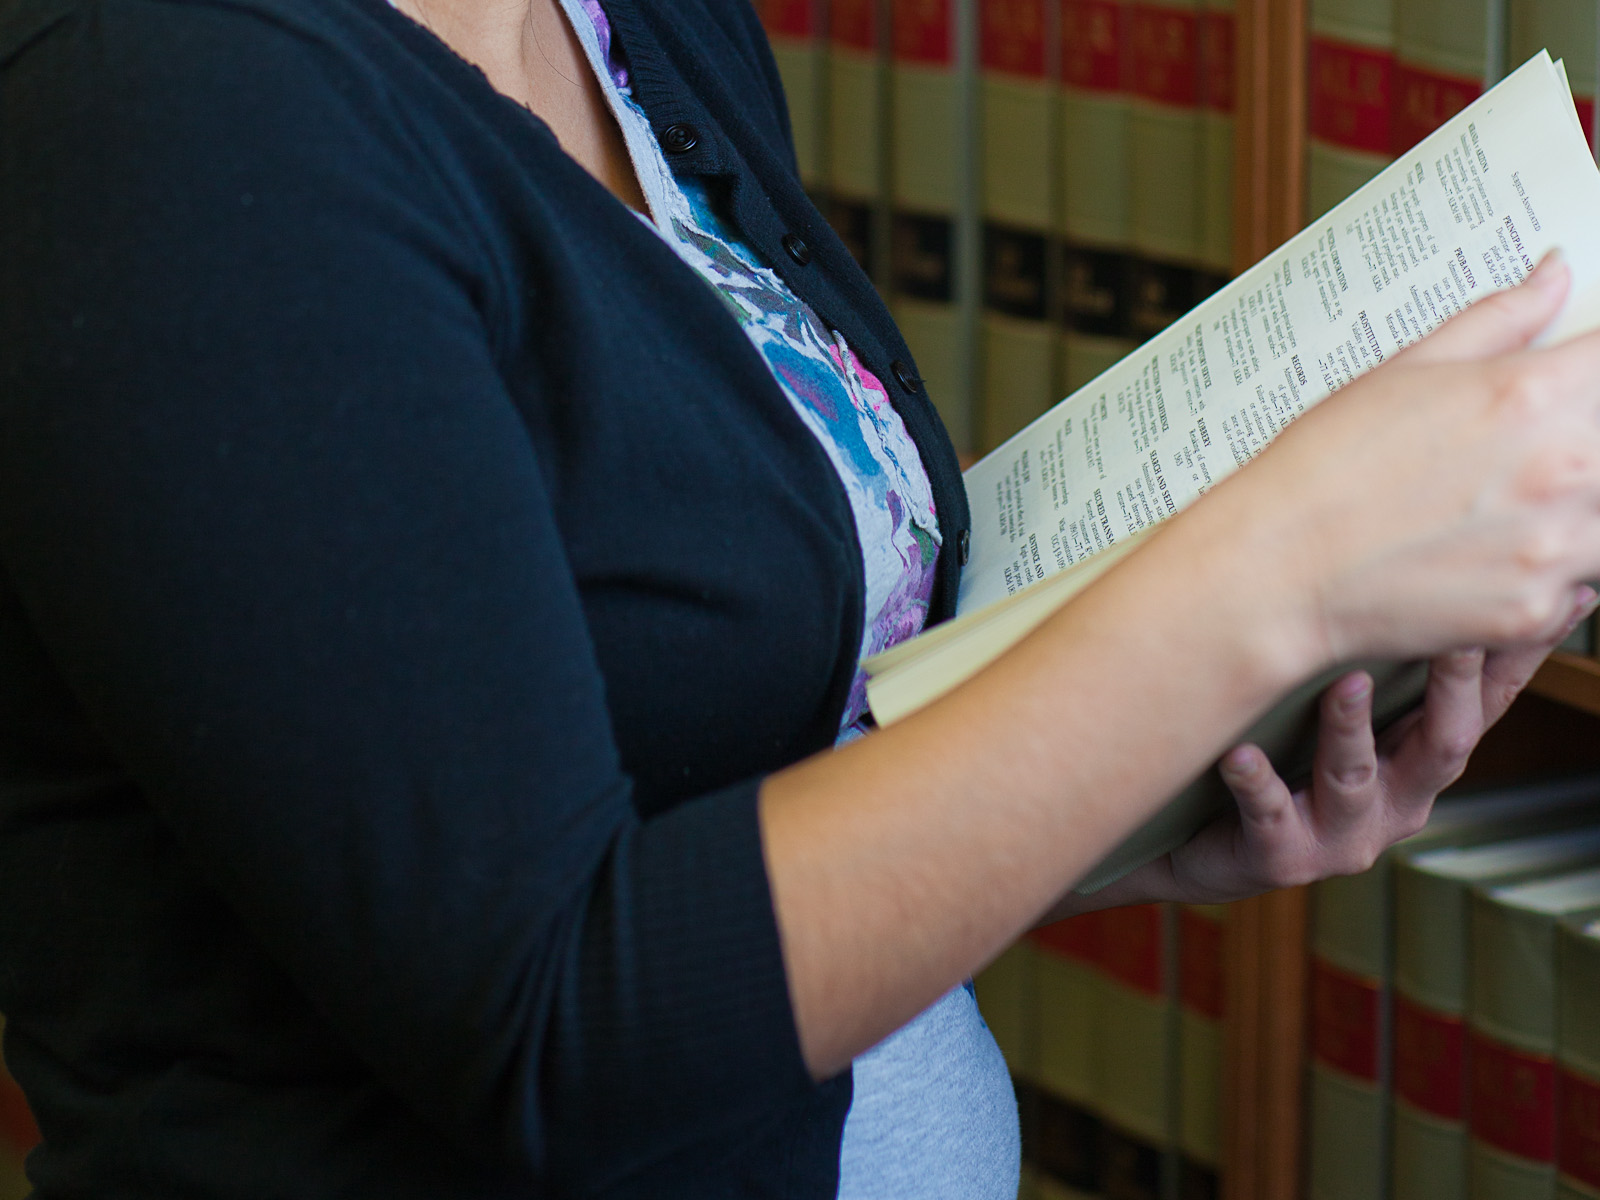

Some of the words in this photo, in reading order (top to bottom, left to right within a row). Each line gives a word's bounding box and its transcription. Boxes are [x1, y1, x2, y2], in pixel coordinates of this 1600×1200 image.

[1475, 148, 1488, 173] ARIZONA
[1471, 175, 1487, 200] probation
[1510, 170, 1525, 197] SUBJECTS
[1521, 196, 1541, 231] ANNOTATED
[1461, 200, 1472, 223] violation
[1469, 222, 1478, 230] of
[1426, 233, 1435, 241] of
[1429, 243, 1439, 254] trial
[1495, 226, 1510, 253] Doctrine
[1502, 215, 1524, 253] PRINCIPAL
[1519, 253, 1534, 271] AND
[1330, 249, 1348, 291] CORPORATIONS
[1454, 247, 1477, 288] PROBATION
[1481, 251, 1496, 273] ALR3d
[1491, 272, 1503, 287] 925
[1488, 245, 1503, 261] plied
[1499, 262, 1506, 271] to
[1508, 254, 1517, 263] of
[1446, 259, 1466, 299] Admissibility,
[1512, 265, 1525, 283] appa
[1403, 301, 1412, 315] tion
[1408, 284, 1428, 323] Admissibility,
[1425, 322, 1433, 332] in
[1432, 282, 1446, 302] tained
[1441, 304, 1452, 320] thro
[1441, 276, 1451, 290] tion
[1446, 291, 1462, 314] procee
[1358, 310, 1385, 363] PROSTITUTION
[1385, 312, 1399, 339] Miranda
[1395, 338, 1404, 351] Ru
[1394, 307, 1410, 337] statement
[1407, 316, 1423, 339] procee
[1335, 344, 1343, 355] for
[1345, 339, 1361, 369] ordinance
[1350, 321, 1362, 344] Validity
[1359, 345, 1370, 358] and
[1290, 354, 1307, 385] RECORDS
[1326, 351, 1335, 367] ness,
[1332, 367, 1339, 375] or
[1336, 376, 1344, 388] ass
[1337, 356, 1354, 382] purpose
[1255, 384, 1265, 404] Failure
[1277, 383, 1286, 391] of
[1278, 392, 1292, 411] police
[1283, 366, 1300, 402] Admissibility
[1297, 401, 1304, 411] in
[1261, 404, 1270, 412] of
[1265, 411, 1277, 434] vendor
[1278, 416, 1289, 429] AL
[1196, 417, 1211, 447] ROBBERY
[1221, 419, 1231, 433] void
[1226, 433, 1232, 441] or
[1230, 414, 1239, 428] ance
[1235, 428, 1244, 436] of
[1239, 408, 1254, 437] recording
[1251, 437, 1261, 446] of
[1252, 410, 1268, 440] ordinance
[1188, 428, 1200, 454] Retaking
[1149, 449, 1161, 475] SEARCH
[1156, 474, 1166, 490] AND
[1182, 445, 1193, 468] robbery
[1192, 472, 1199, 481] or
[1196, 453, 1205, 461] of
[1134, 477, 1142, 490] tion
[1199, 461, 1212, 484] money
[1093, 488, 1105, 515] SECURED
[1125, 483, 1136, 501] tained
[1131, 502, 1145, 529] through
[1136, 490, 1155, 526] proceeding
[1152, 495, 1159, 505] in
[1085, 499, 1095, 520] Secured
[1090, 521, 1104, 550] transactio
[1028, 533, 1040, 563] SENTENCE
[1034, 563, 1044, 578] AND
[1050, 533, 1059, 548] UCC
[1061, 535, 1074, 565] constitutes
